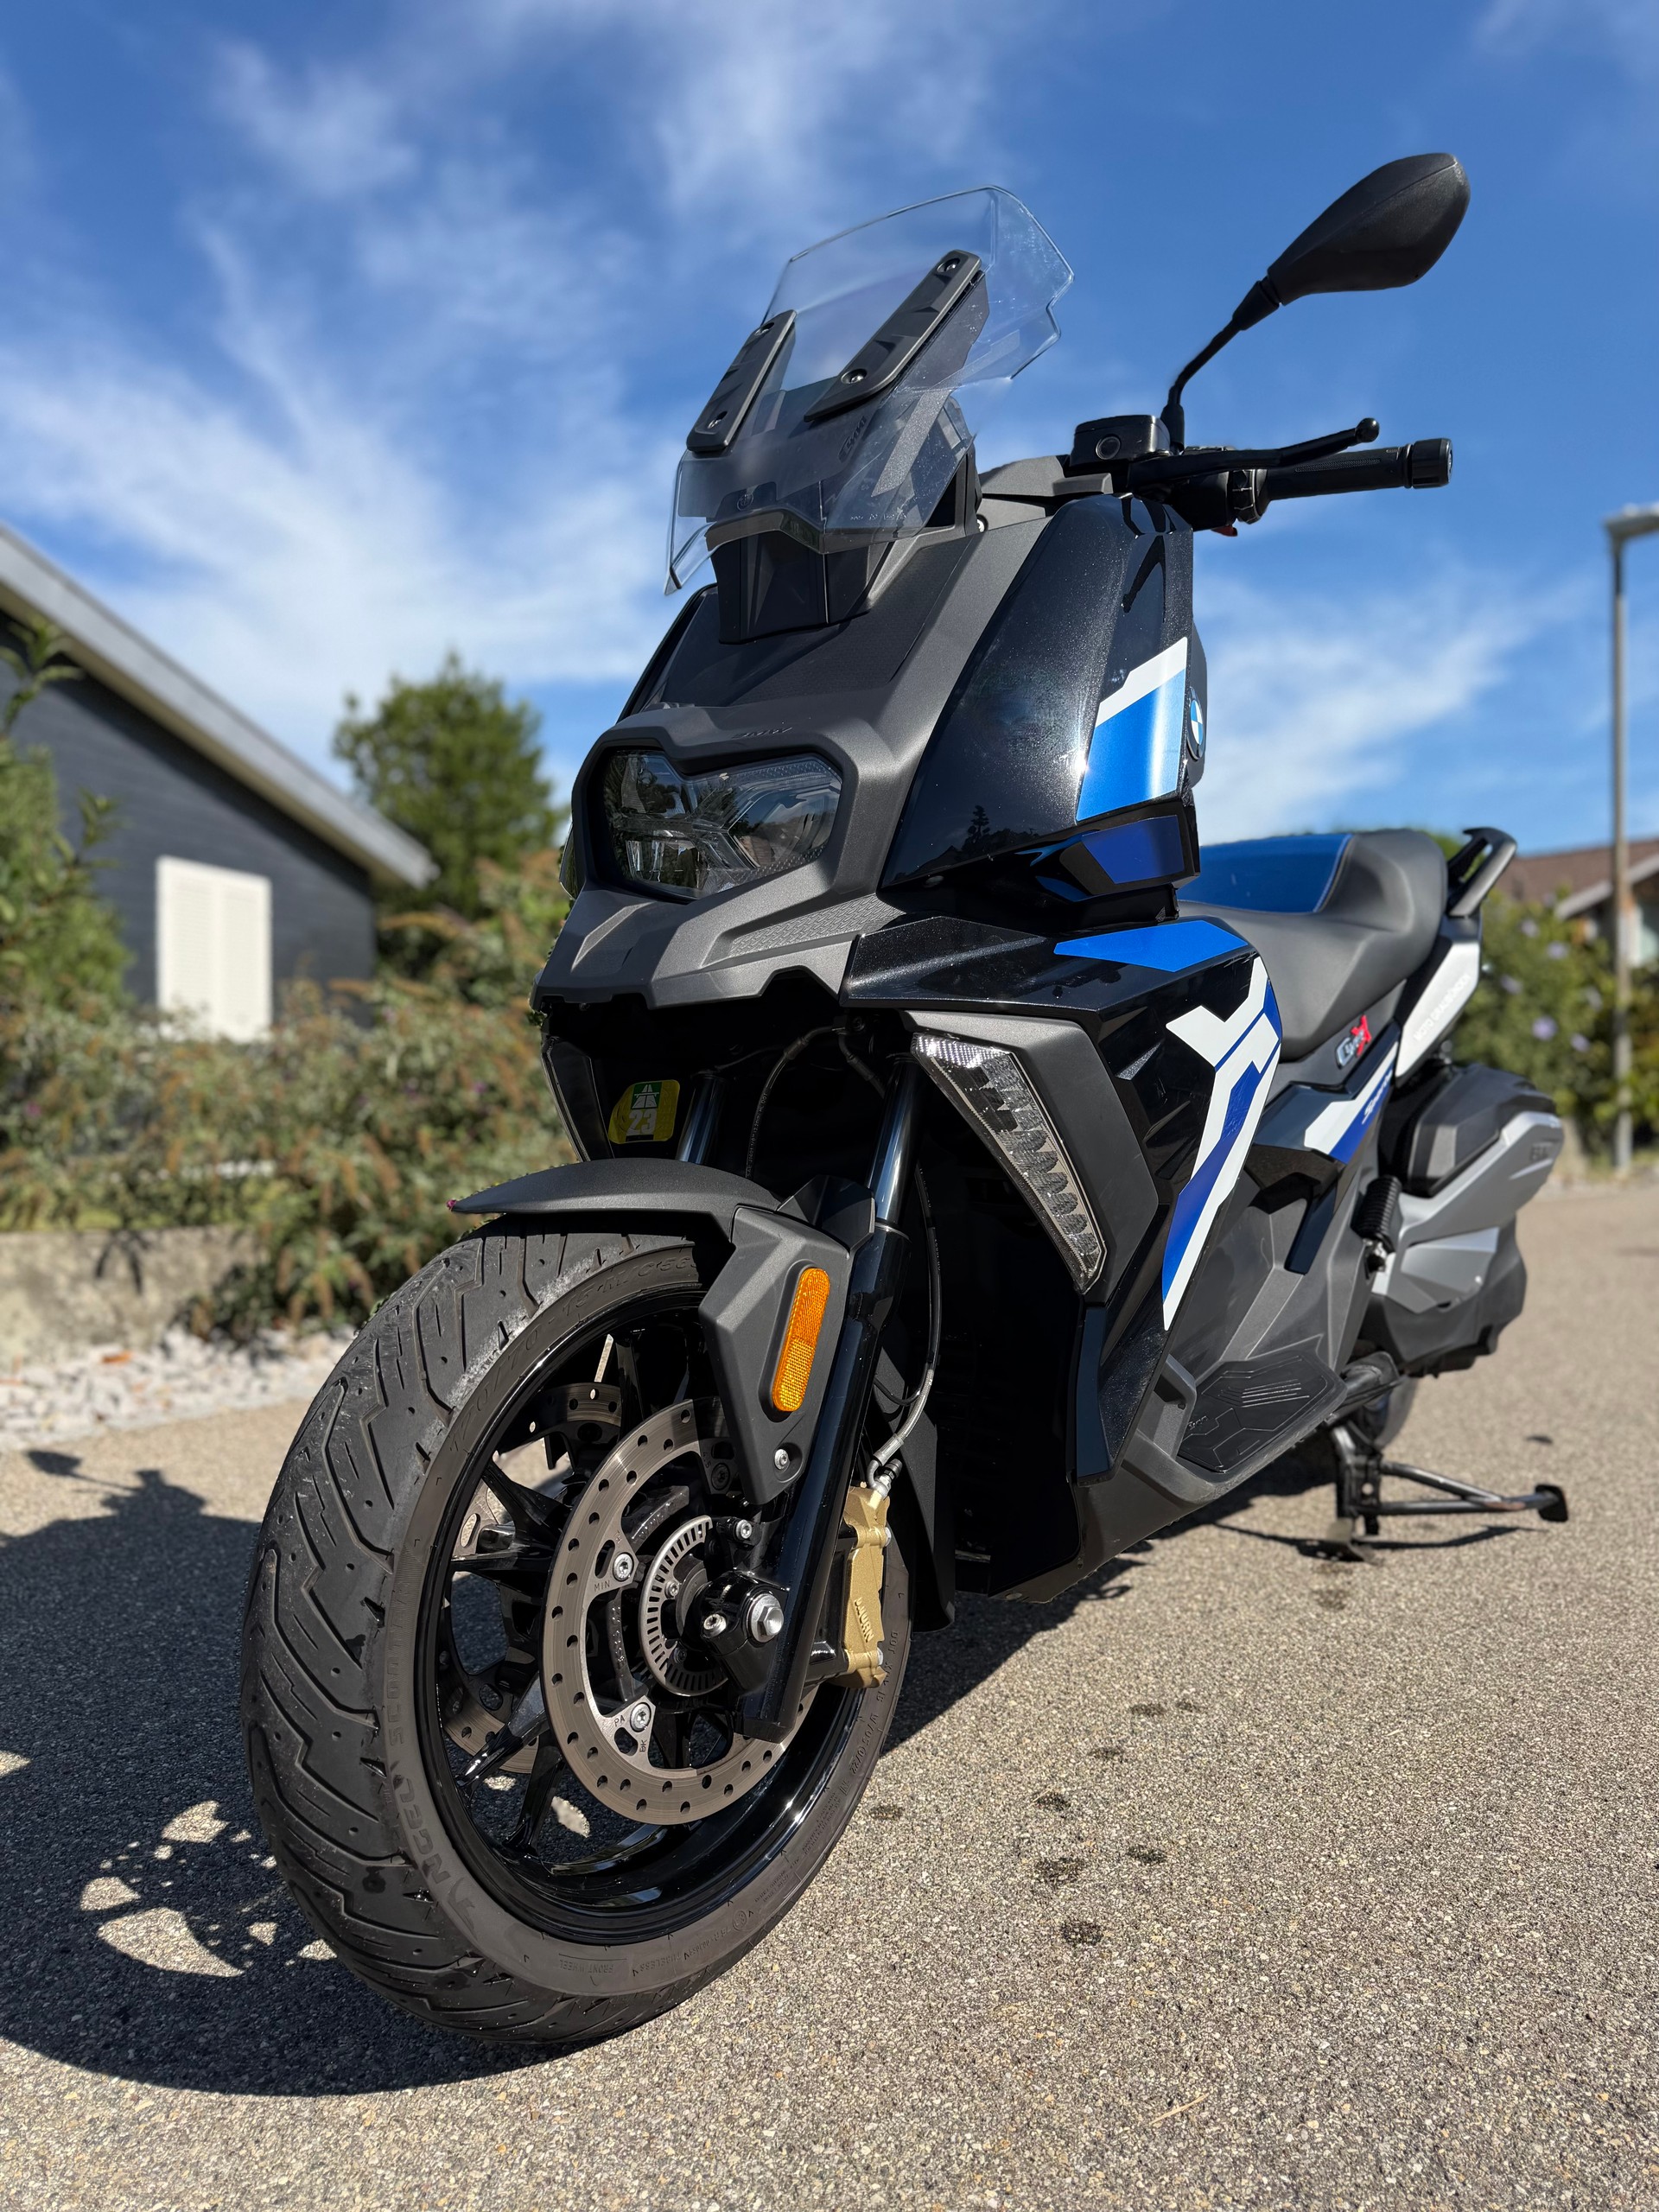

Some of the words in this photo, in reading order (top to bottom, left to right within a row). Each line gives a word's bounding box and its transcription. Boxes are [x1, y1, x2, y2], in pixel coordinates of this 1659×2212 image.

[626, 1109, 658, 1136] 23
[594, 1580, 610, 1592] MIN
[887, 1631, 899, 1655] DOT
[588, 1963, 614, 1974] FRONT
[639, 1955, 682, 1973] TUBELESS
